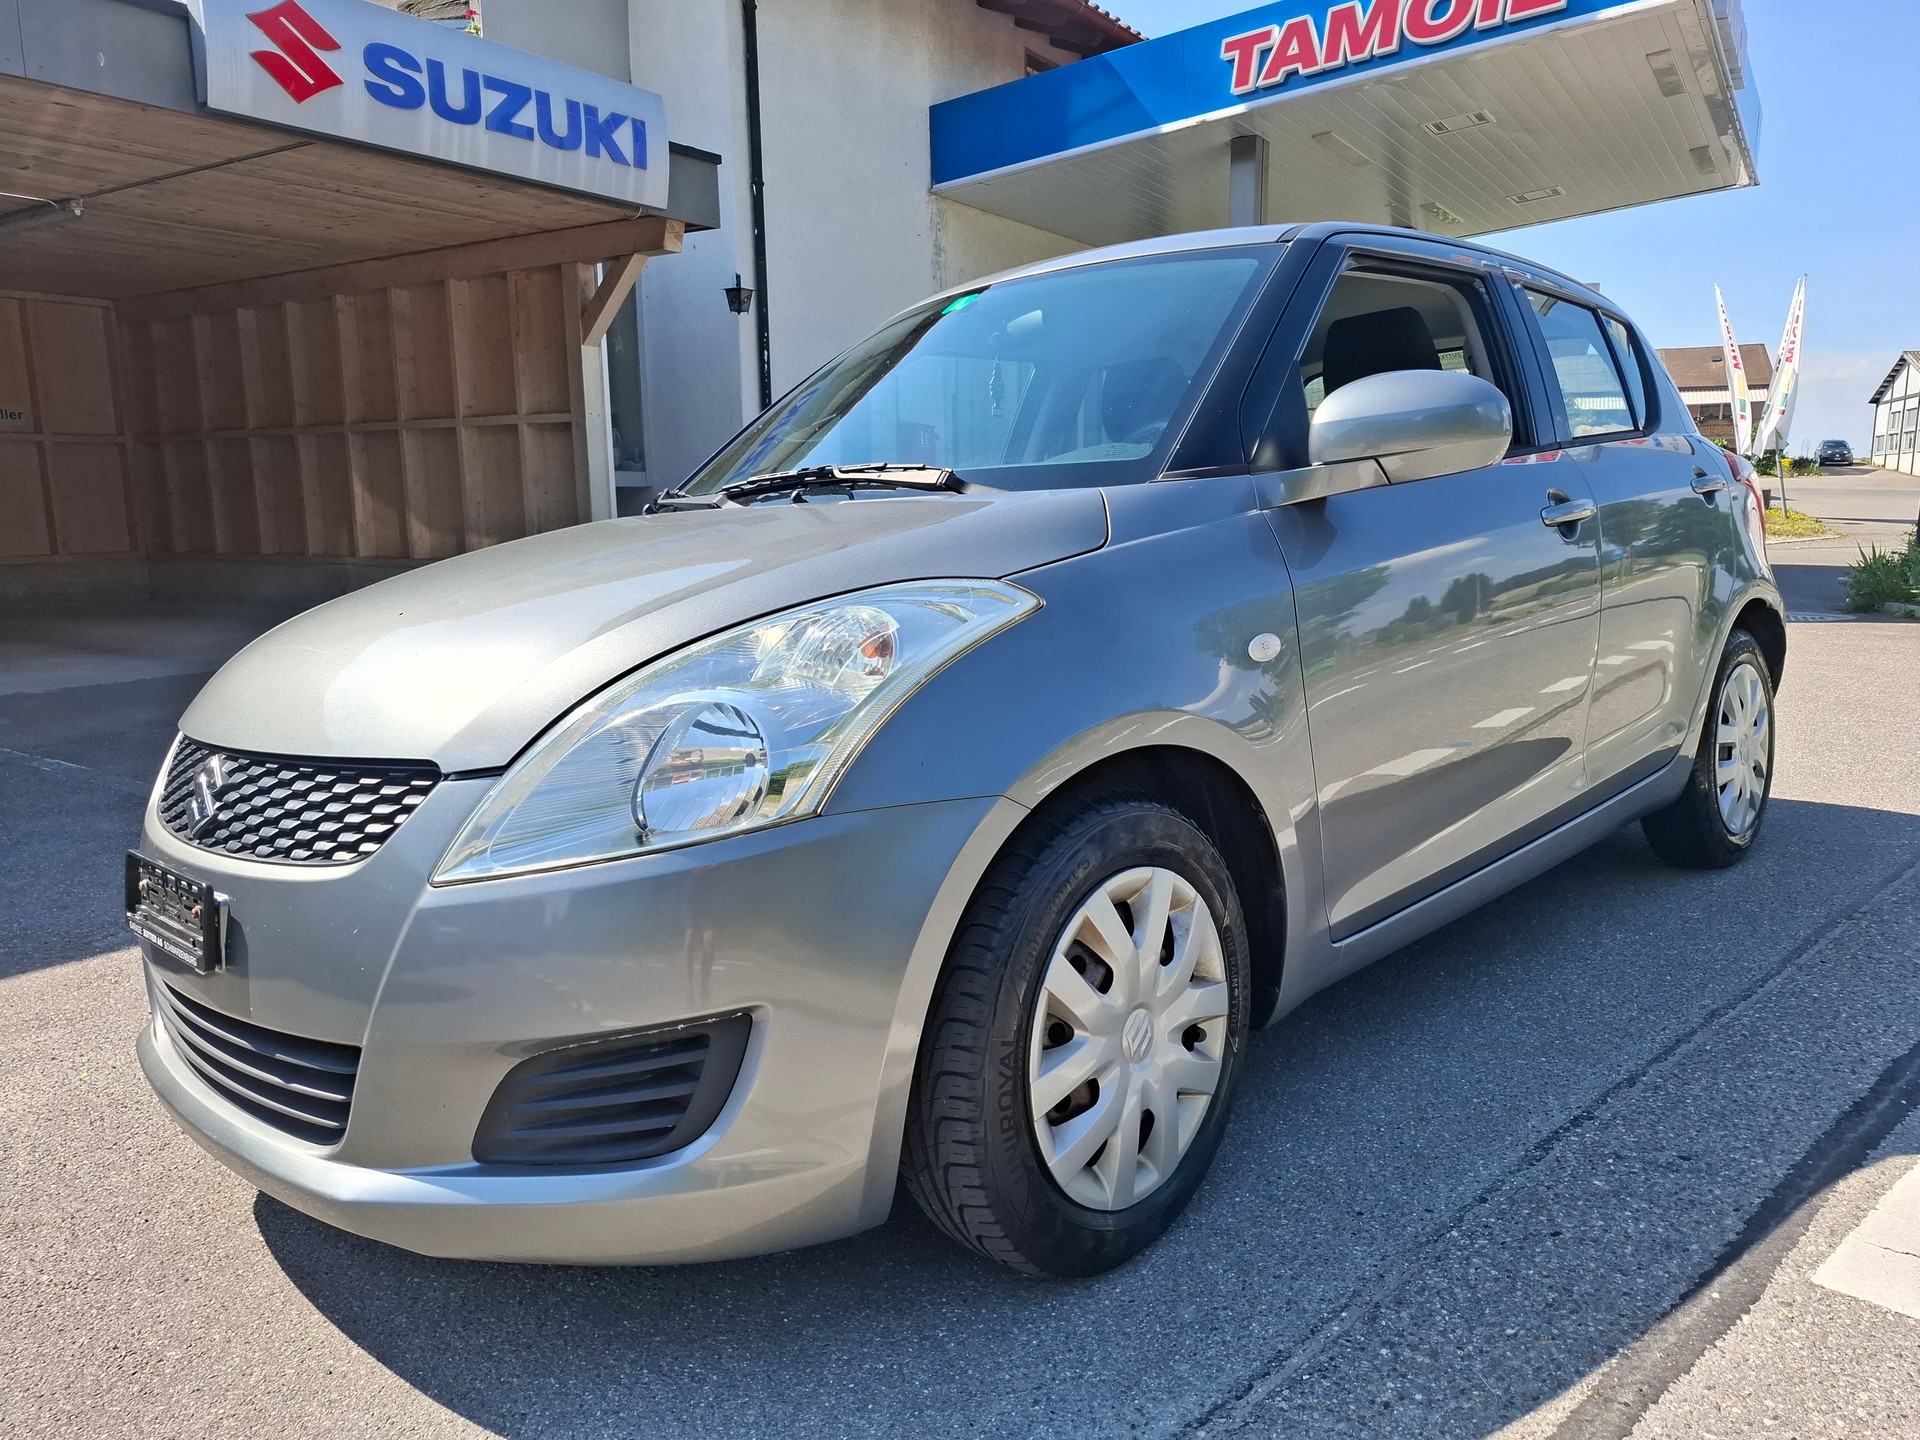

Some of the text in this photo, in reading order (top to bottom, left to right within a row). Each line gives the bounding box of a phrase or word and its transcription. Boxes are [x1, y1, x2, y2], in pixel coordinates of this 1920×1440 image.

[1220, 0, 1567, 96] TAMO
[362, 41, 648, 170] SUZUKI
[1225, 932, 1240, 1031] THE RAIN TYRE
[998, 1040, 1023, 1184] UNIROYAL
